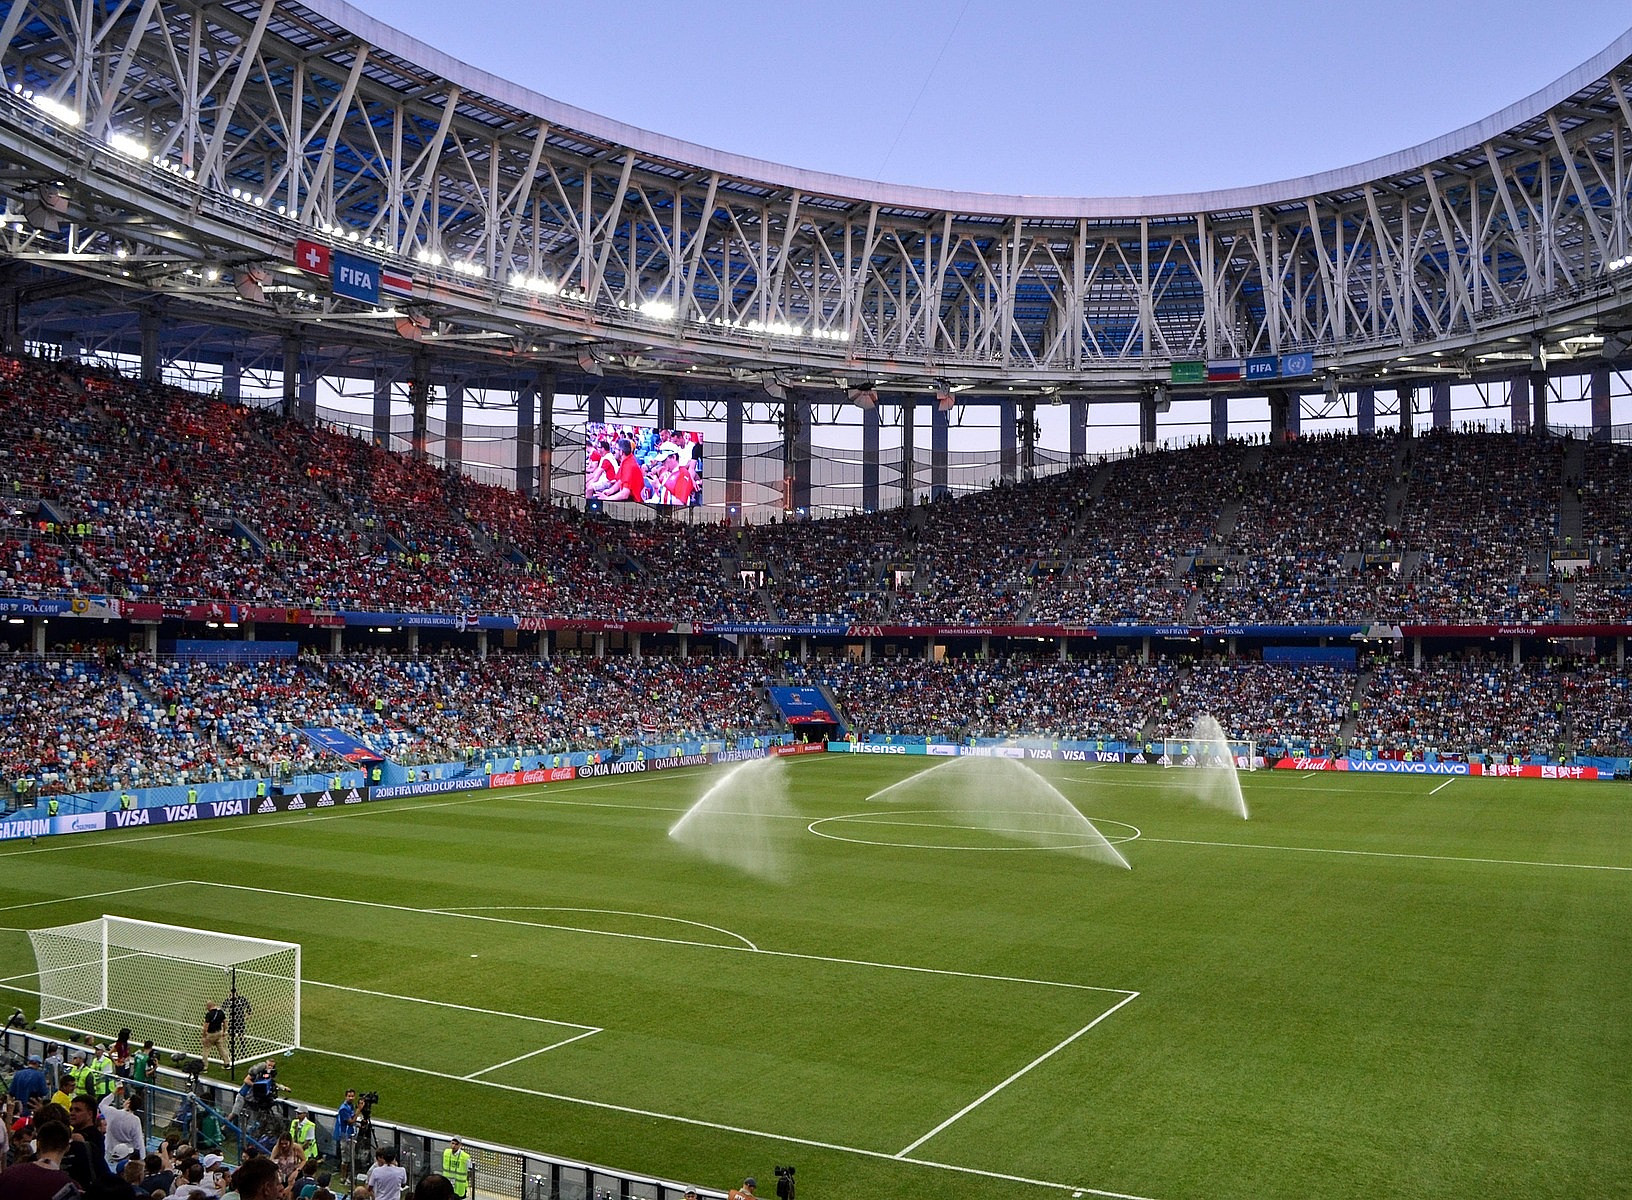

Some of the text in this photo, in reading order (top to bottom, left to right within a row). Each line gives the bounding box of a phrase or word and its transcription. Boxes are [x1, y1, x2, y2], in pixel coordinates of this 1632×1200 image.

[340, 266, 372, 290] FIFA
[1250, 363, 1272, 374] FIFA
[741, 748, 766, 760] WANDA
[849, 741, 906, 754] Hisense
[1029, 749, 1053, 759] VISA
[655, 754, 707, 769] QATAR AIRWAYS
[1062, 750, 1086, 760] VISA
[1095, 752, 1120, 762] VISA
[593, 764, 607, 776] KIA
[610, 760, 646, 775] MOTORS
[1293, 757, 1327, 770] Bud
[375, 778, 483, 798] 2018 FIFA WORLD CUP RUSSIA
[163, 804, 198, 822] VISA
[210, 800, 243, 817] VISA
[257, 806, 277, 814] adidas
[287, 803, 306, 811] adidas
[112, 809, 150, 827] VISA
[0, 818, 50, 839] GAZPROM
